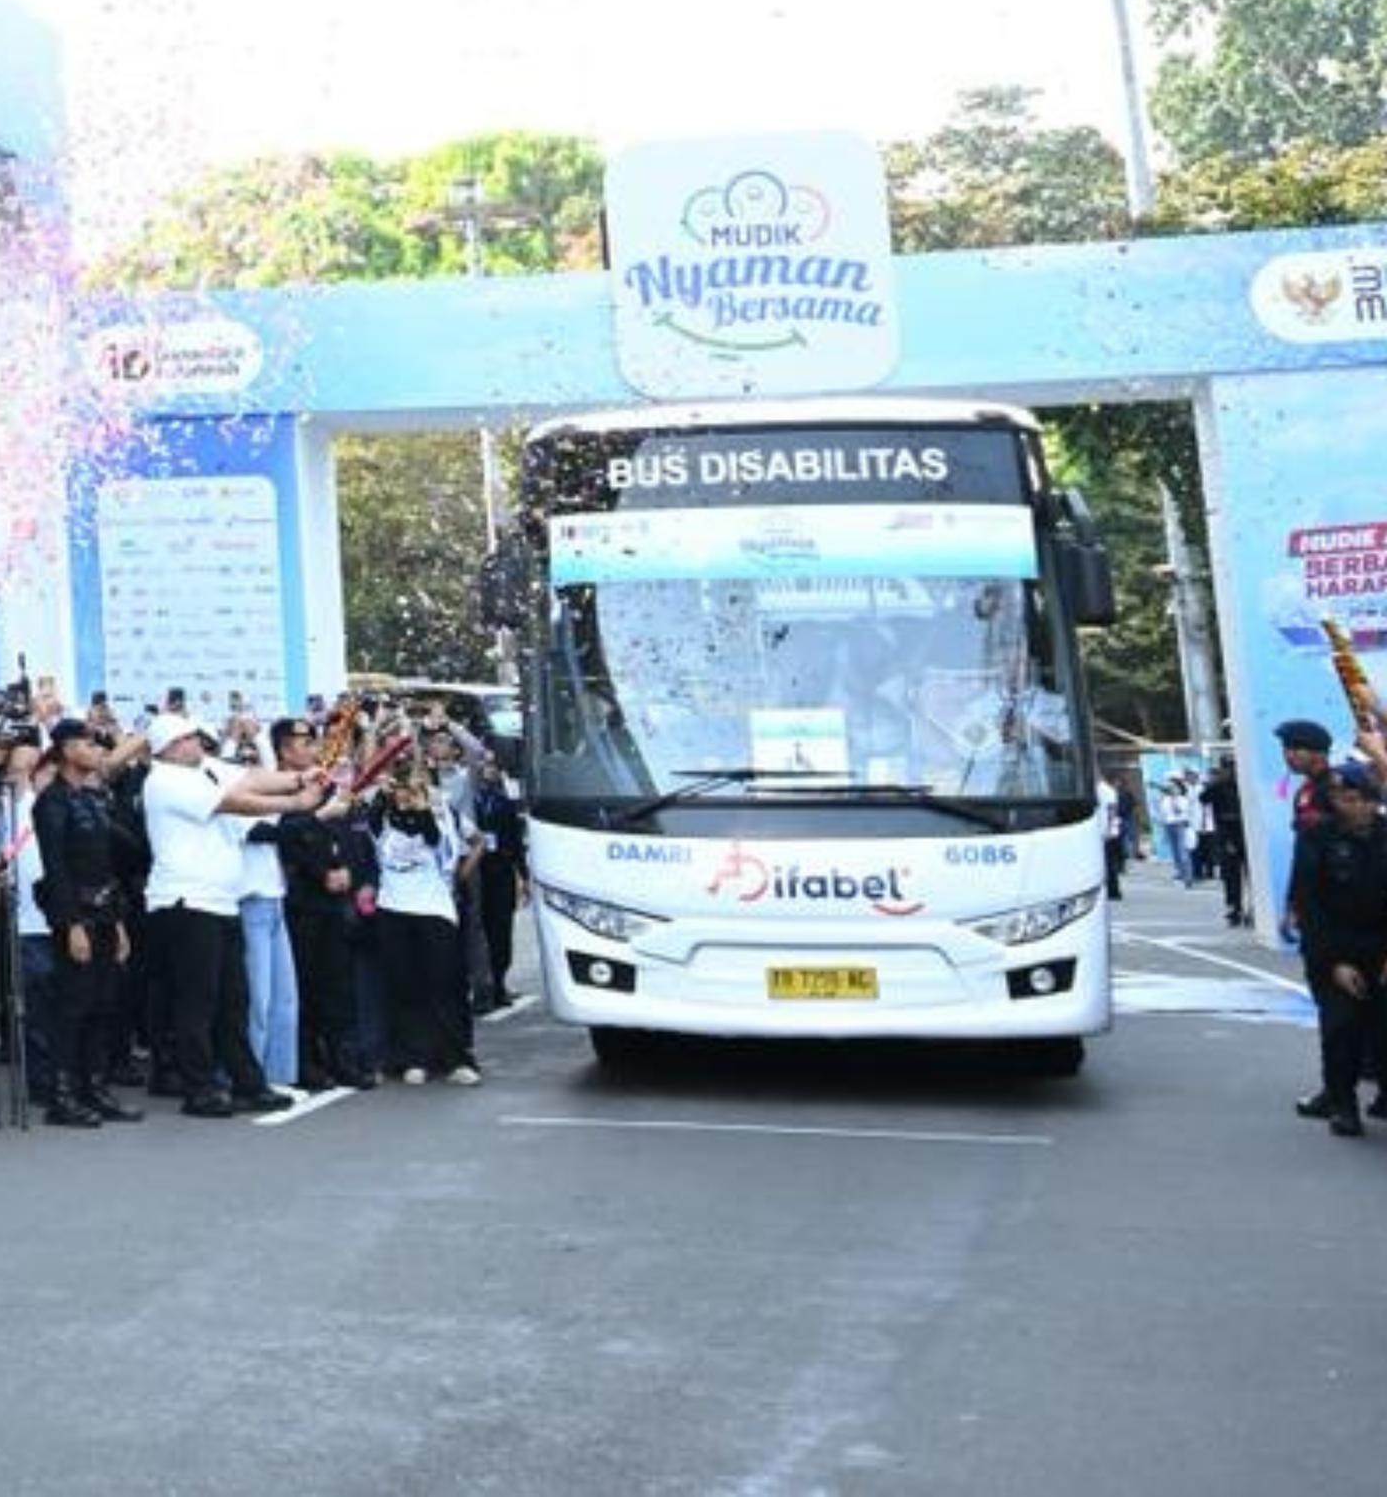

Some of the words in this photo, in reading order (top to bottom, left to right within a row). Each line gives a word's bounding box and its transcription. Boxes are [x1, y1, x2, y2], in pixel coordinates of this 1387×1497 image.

[711, 224, 801, 247] MUDIK
[625, 253, 874, 309] Nyaman
[706, 292, 886, 328] Bersama
[608, 454, 688, 490] BUS
[700, 448, 948, 485] DISABILITAS
[1306, 553, 1387, 579] BERB
[944, 844, 1018, 864] 6086
